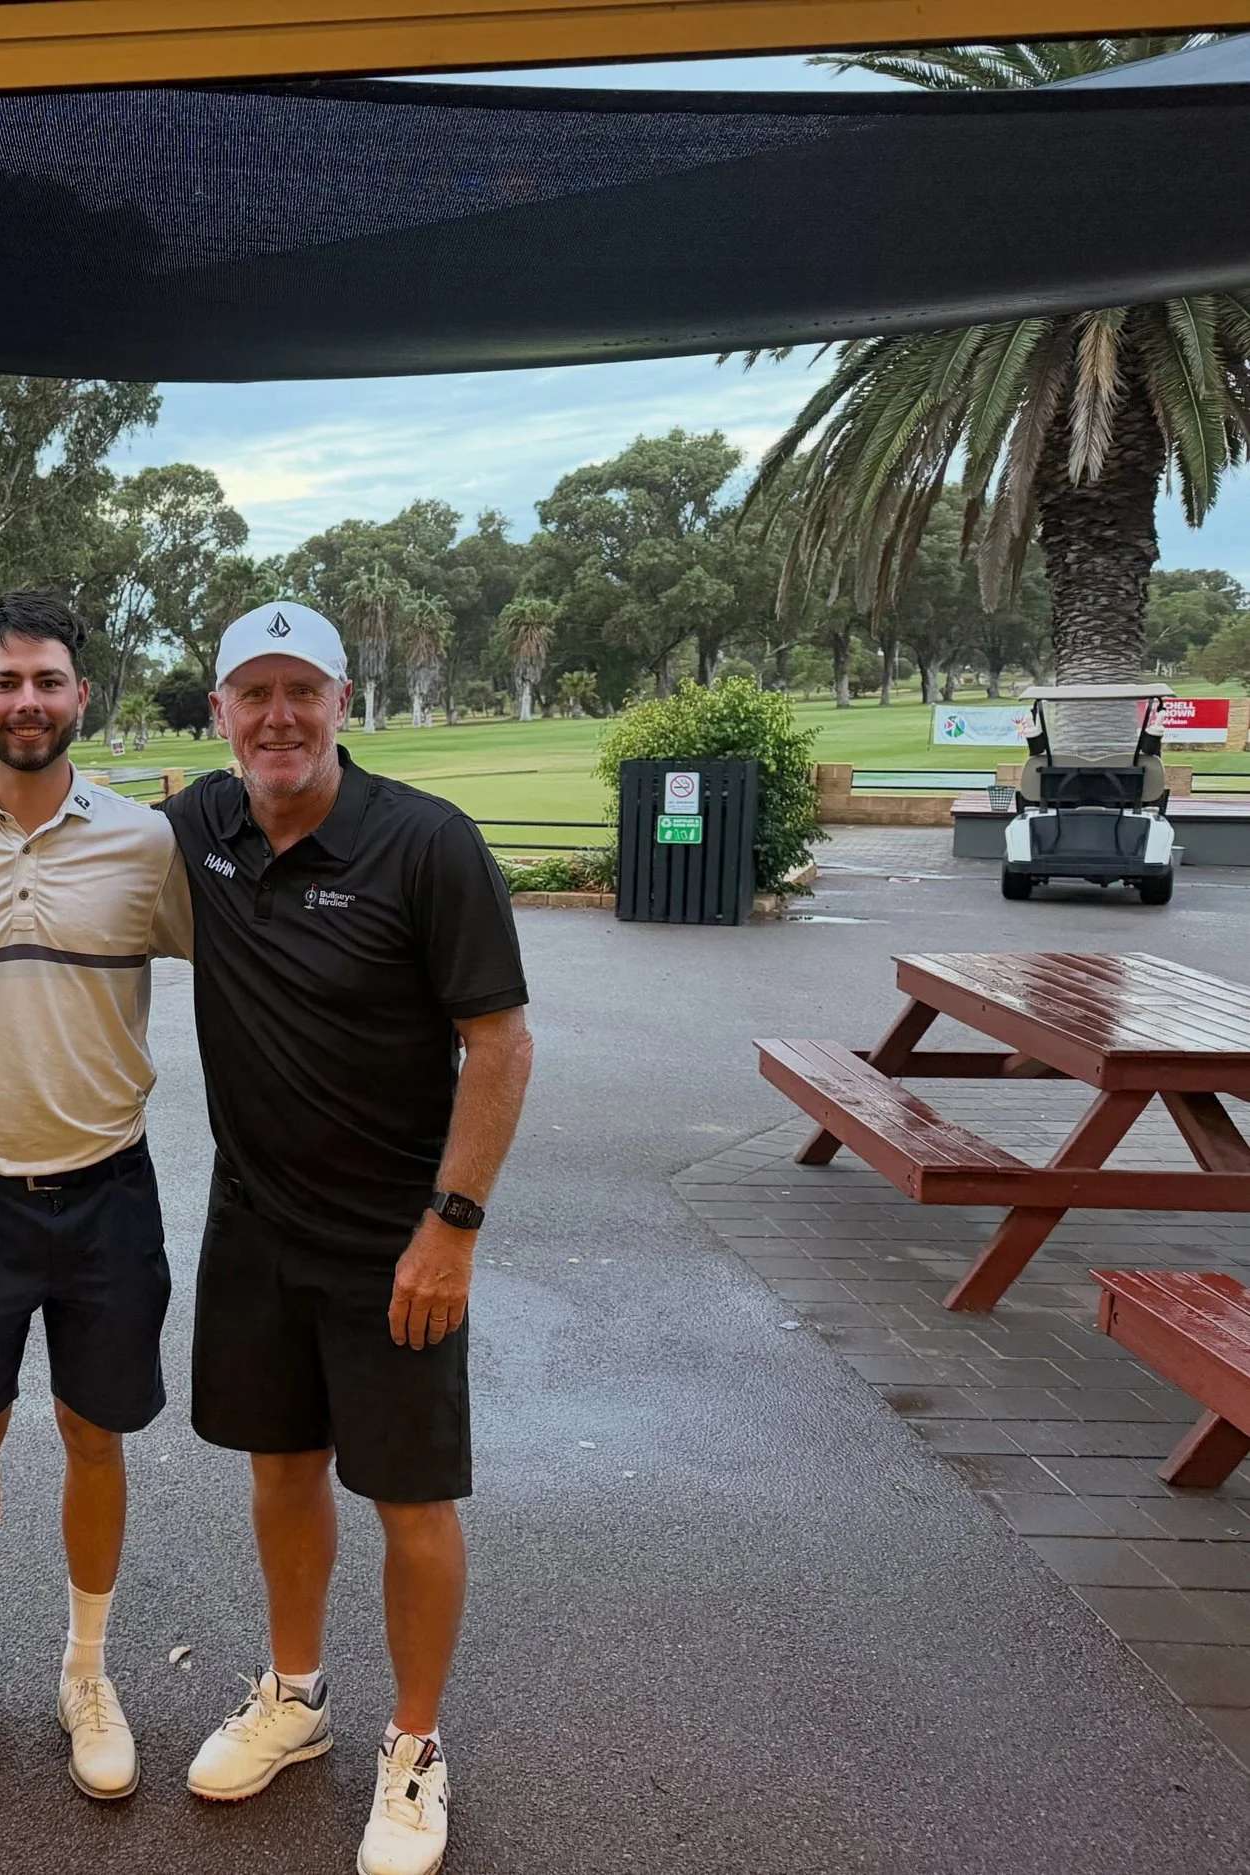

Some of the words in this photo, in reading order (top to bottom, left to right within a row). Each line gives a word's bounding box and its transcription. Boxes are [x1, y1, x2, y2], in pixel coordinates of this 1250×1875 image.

[203, 852, 237, 879] HAHN
[320, 890, 356, 901] Bullseye
[318, 897, 349, 908] Birdies
